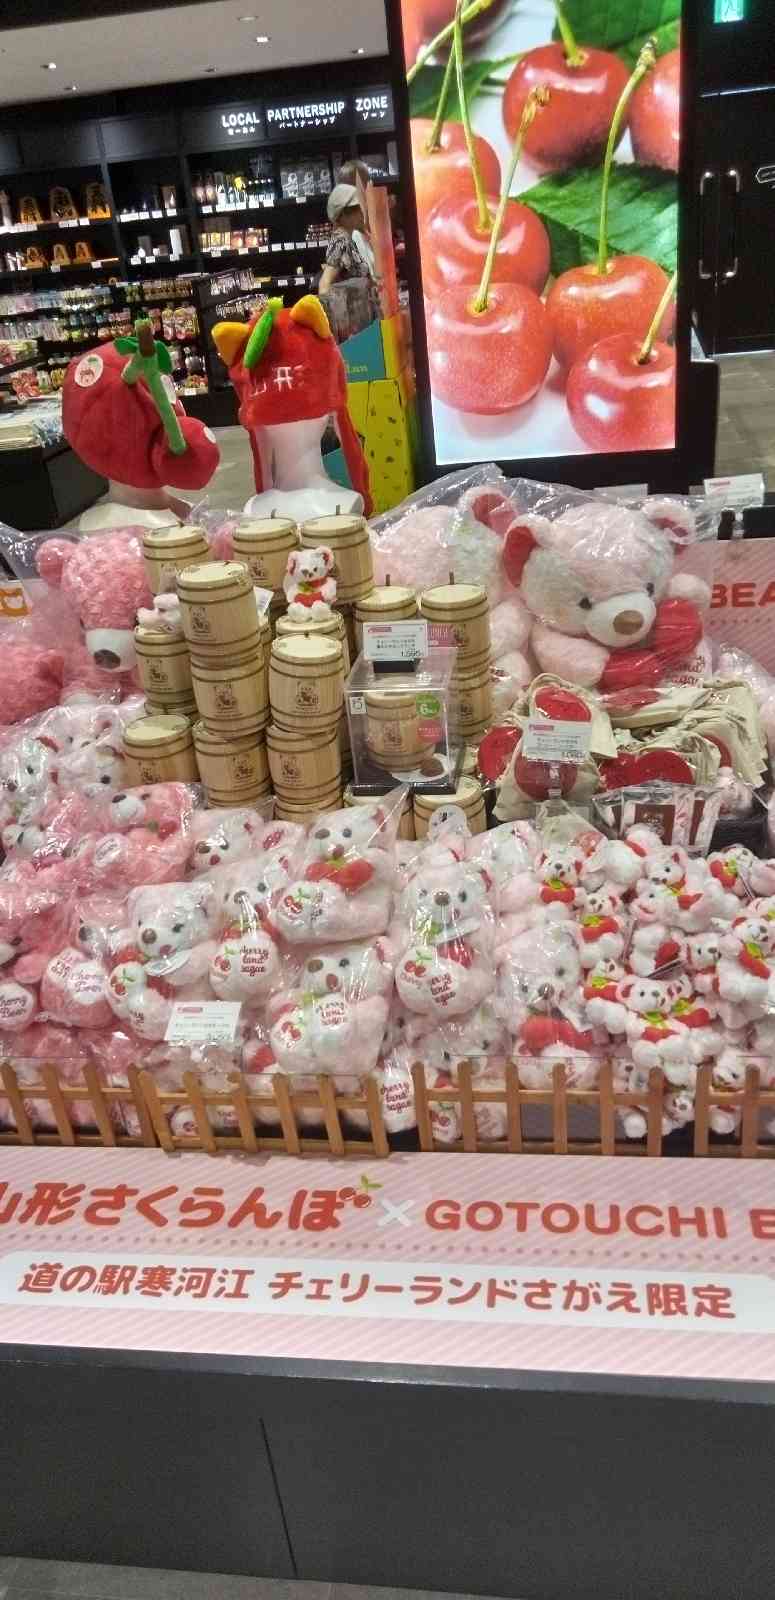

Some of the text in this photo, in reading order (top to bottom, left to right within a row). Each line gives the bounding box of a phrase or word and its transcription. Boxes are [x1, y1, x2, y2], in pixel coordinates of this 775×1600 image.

[221, 96, 388, 128] LOCAL PARTNERSHIP ZONE
[424, 1199, 728, 1240] GOTOUCHI
[18, 1262, 736, 1319] 道の駅寒河江 チェリーランドさがえ限定
